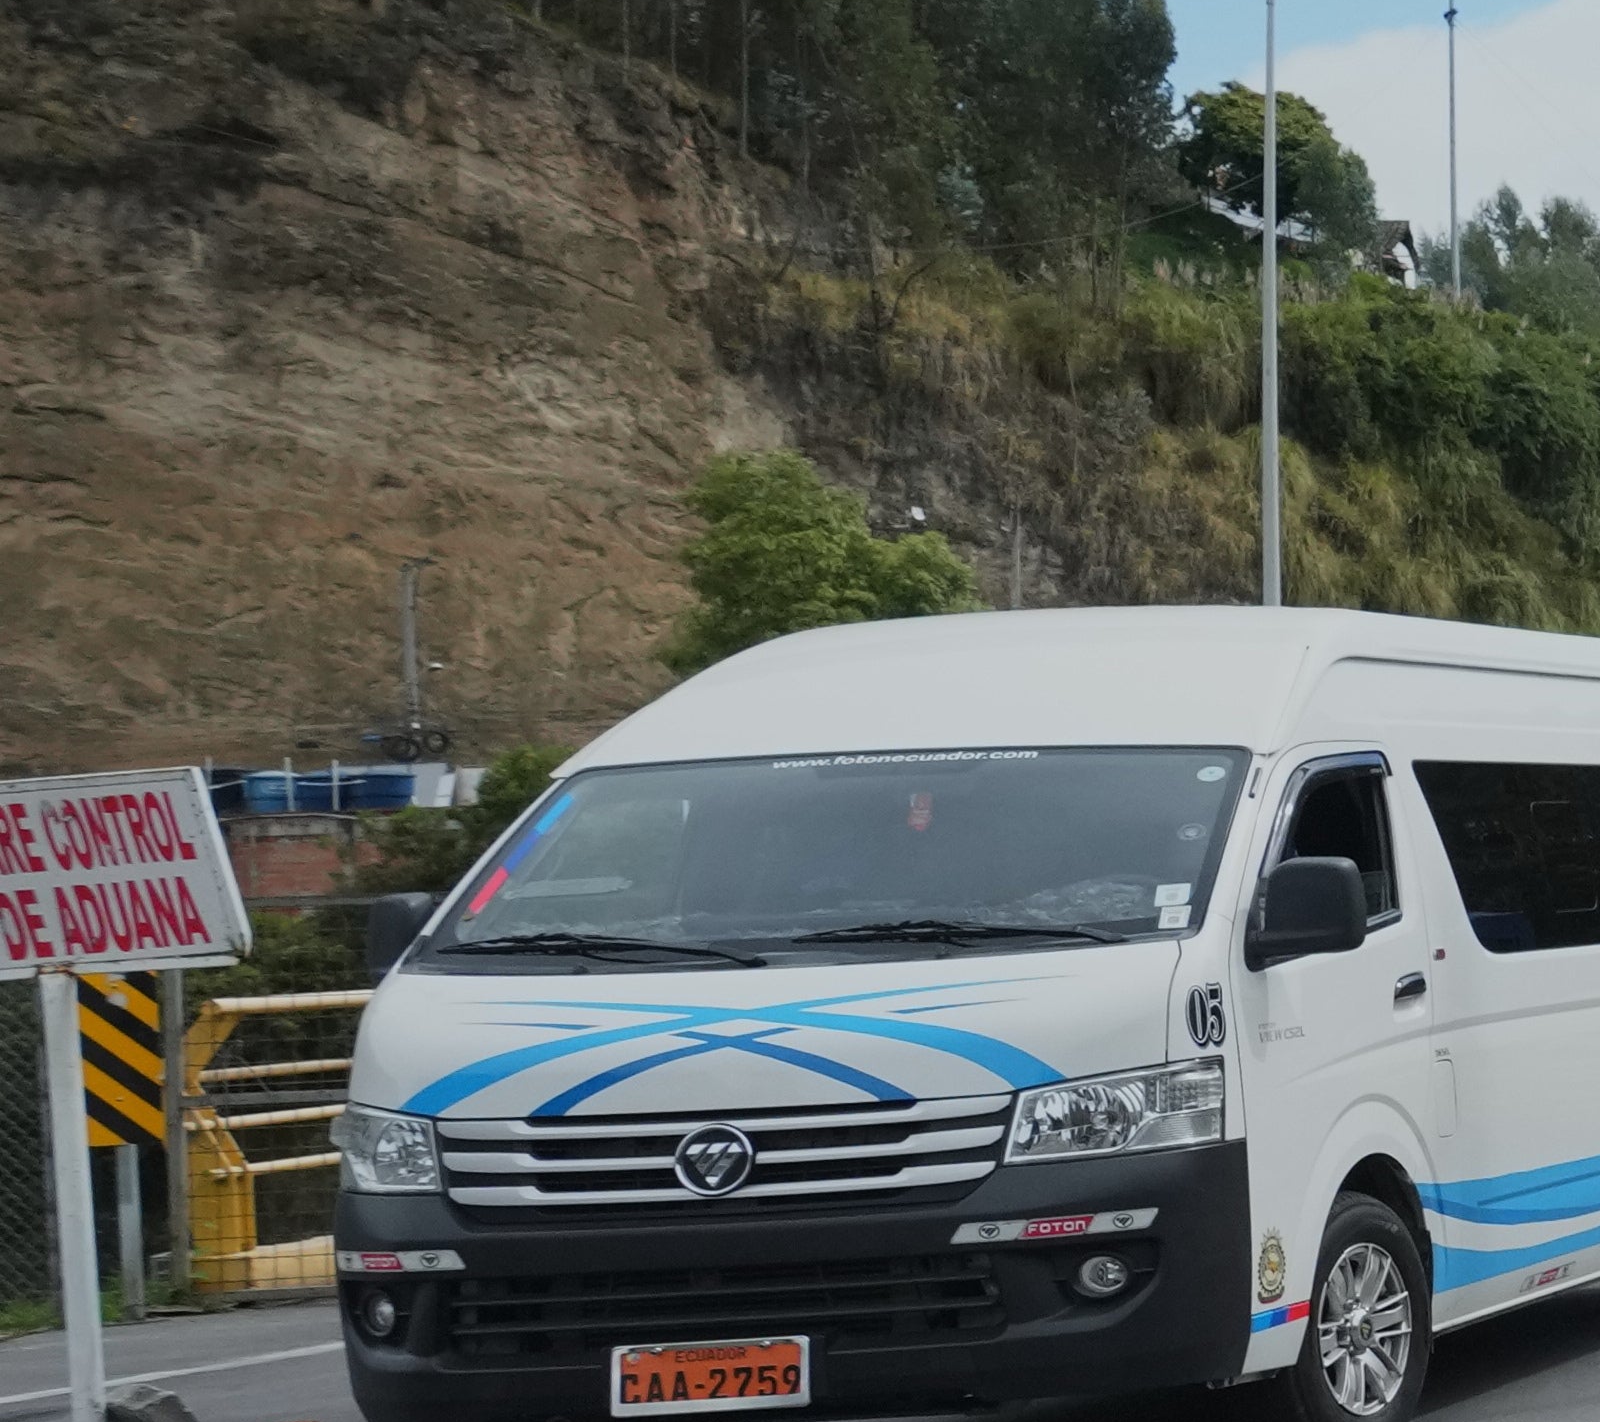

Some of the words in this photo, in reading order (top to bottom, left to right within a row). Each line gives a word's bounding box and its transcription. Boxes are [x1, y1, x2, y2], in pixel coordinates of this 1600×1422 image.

[772, 749, 1039, 770] www.fotonecuador.com
[40, 790, 198, 872] CONTROL
[0, 888, 56, 961] DE
[53, 875, 213, 956] ADUANA
[1184, 981, 1227, 1046] 05
[1027, 1220, 1087, 1235] FOTON
[674, 1346, 748, 1364] ECUADOR
[621, 1363, 801, 1405] CAA-2759
